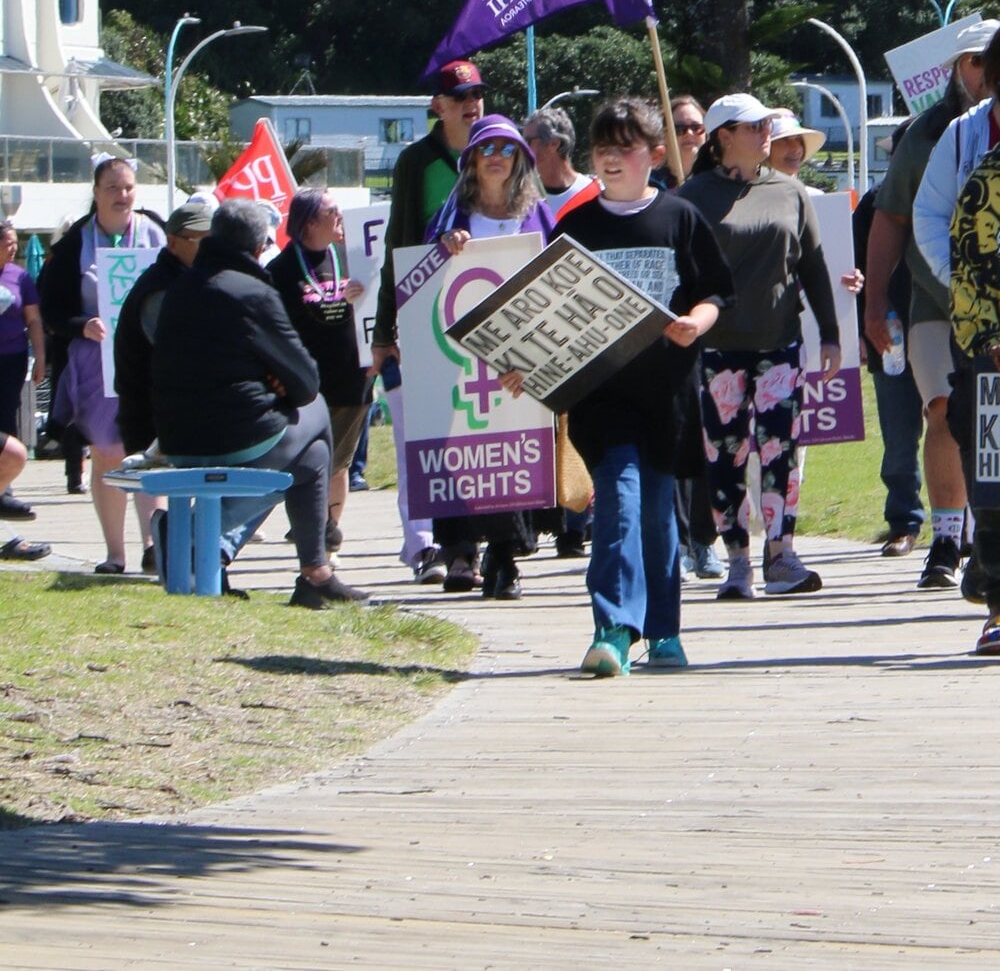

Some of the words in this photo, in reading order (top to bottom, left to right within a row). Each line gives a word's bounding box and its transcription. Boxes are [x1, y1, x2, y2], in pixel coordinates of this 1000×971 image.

[398, 248, 445, 296] VOTE
[465, 320, 513, 357] ME
[501, 288, 551, 330] ARO
[541, 252, 594, 296] KOE
[494, 347, 537, 374] KI
[521, 320, 569, 356] TE
[592, 275, 624, 302] O
[521, 295, 648, 396] HINE-AHU-ONE
[419, 432, 541, 474] WOMEN'S
[429, 470, 532, 503] RIGHTS
